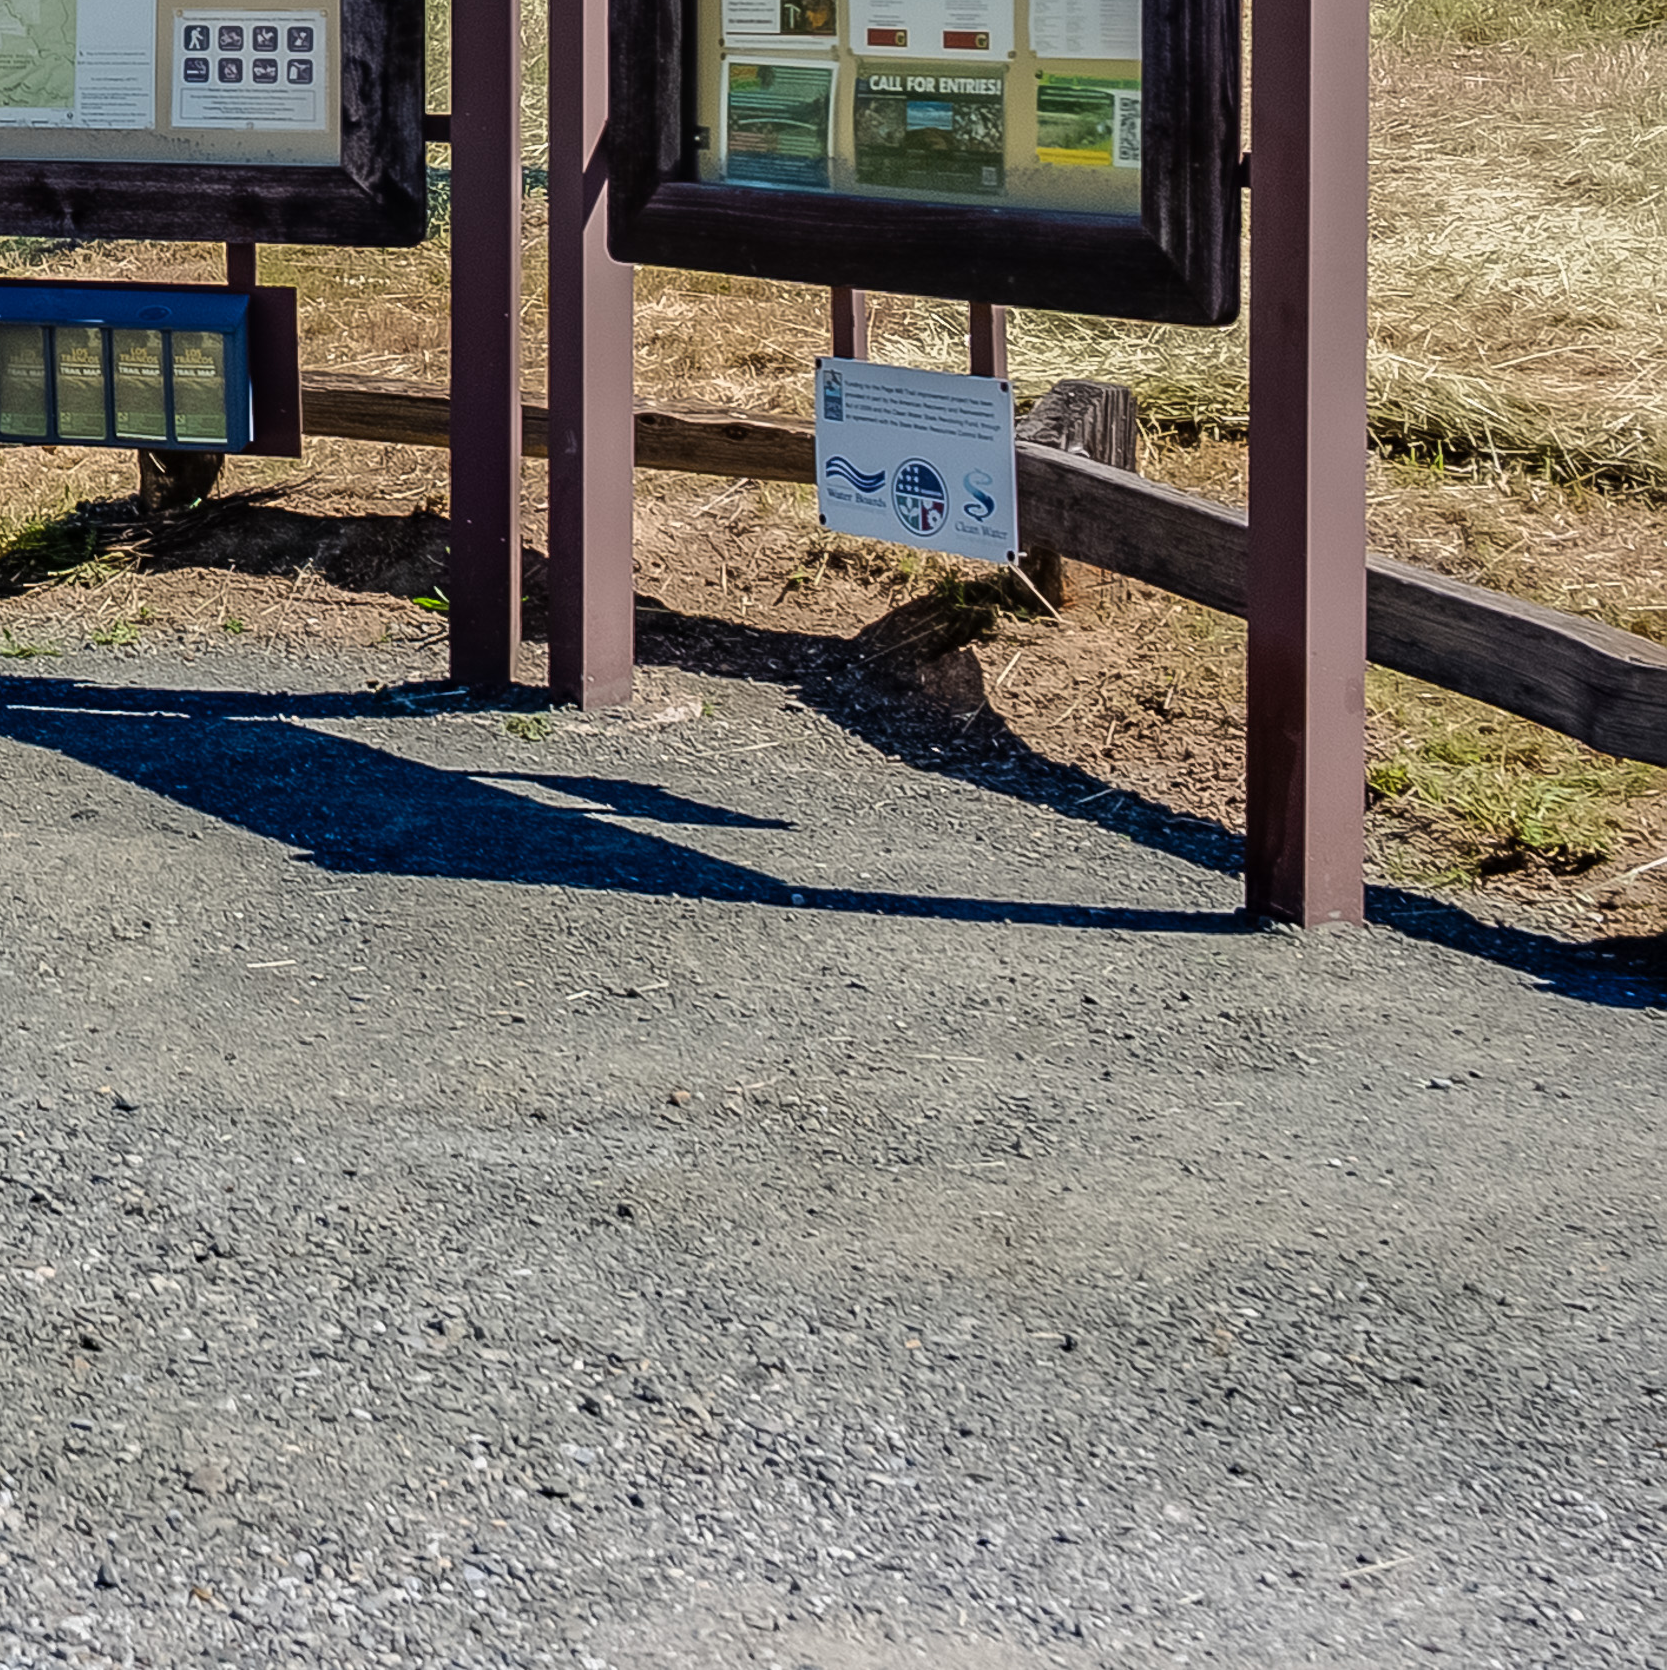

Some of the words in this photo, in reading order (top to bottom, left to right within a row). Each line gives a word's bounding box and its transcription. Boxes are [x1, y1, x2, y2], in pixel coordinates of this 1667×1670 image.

[869, 75, 903, 92] CALL
[906, 76, 936, 93] FOR
[938, 77, 1002, 95] ENTRIES!
[71, 348, 88, 357] LOS
[130, 347, 148, 356] LOS
[185, 349, 202, 358] LOS
[60, 367, 82, 376] TRAIL
[82, 368, 102, 376] MAP
[118, 366, 141, 376] TRAIL
[141, 367, 161, 376] MAP
[174, 368, 196, 377] TRAIL
[197, 369, 216, 377] MAP
[827, 487, 852, 502] Water
[855, 493, 887, 508] Boards
[954, 521, 979, 535] Clean
[981, 525, 1009, 540] Water
